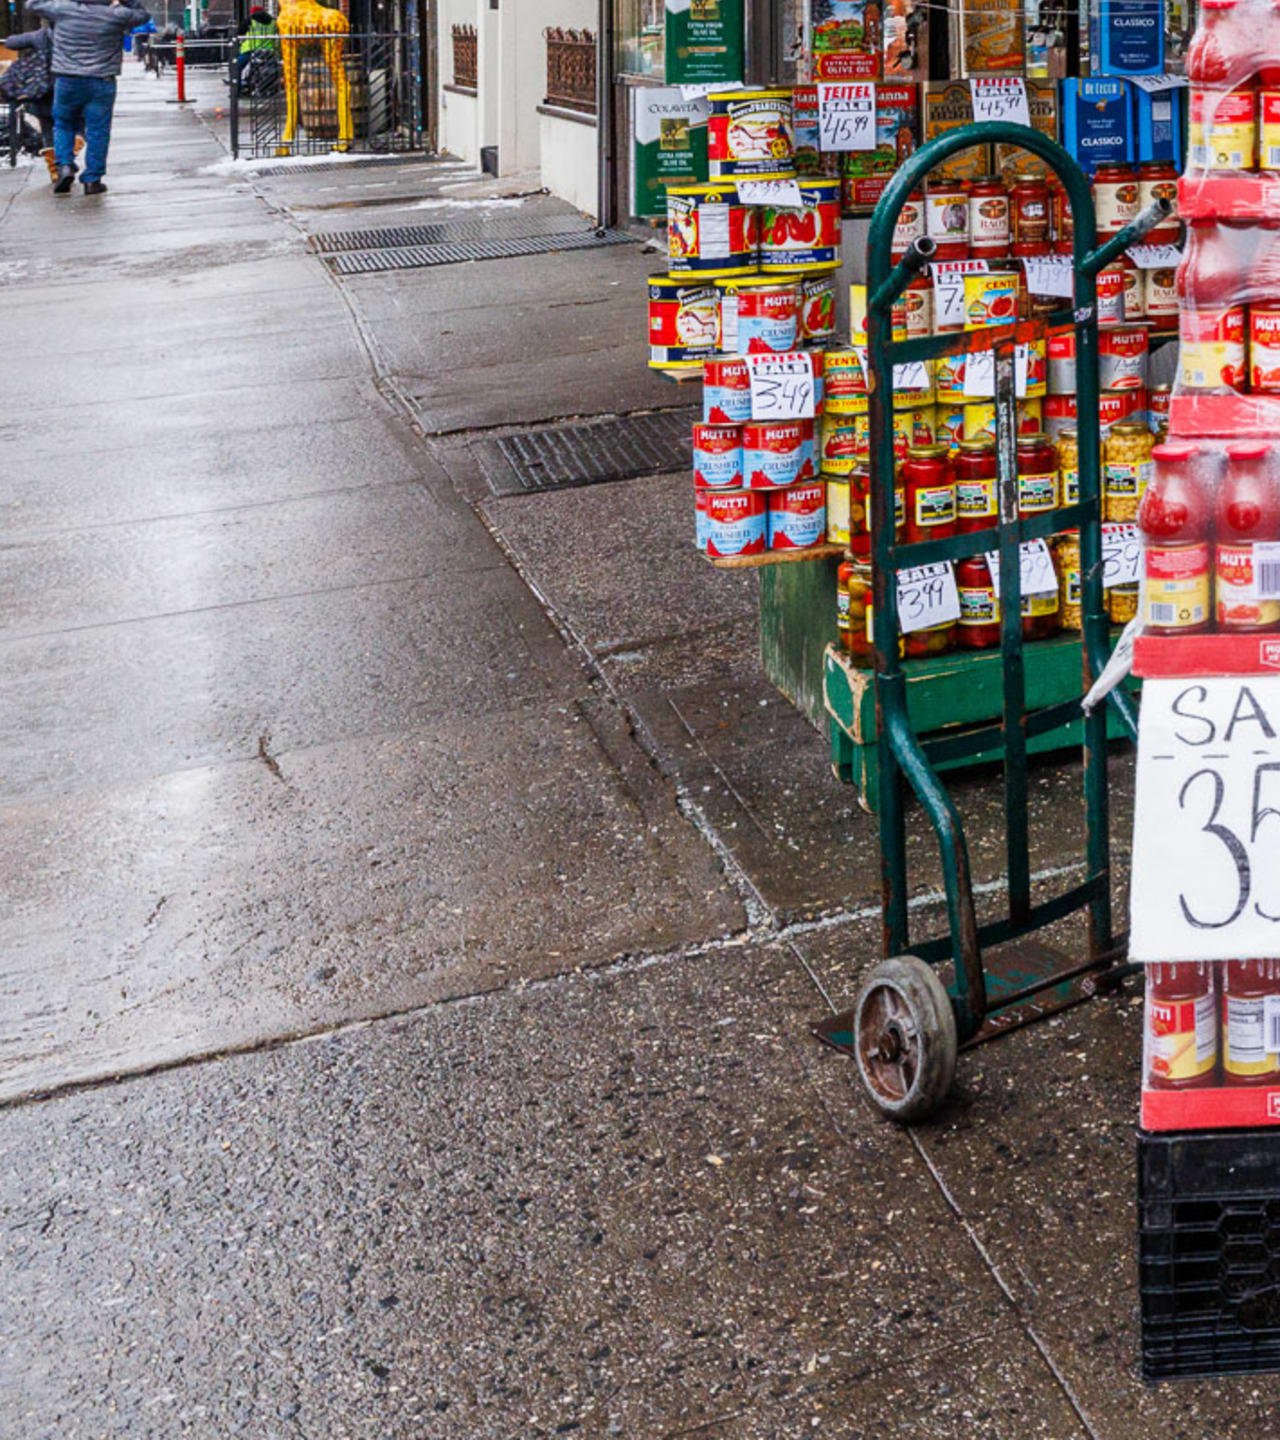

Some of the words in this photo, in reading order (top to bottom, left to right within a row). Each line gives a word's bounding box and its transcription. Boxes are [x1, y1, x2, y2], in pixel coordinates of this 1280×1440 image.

[1114, 18, 1155, 27] CLASSICO
[823, 85, 871, 101] TEITEL
[1081, 136, 1123, 147] CLASSICO
[937, 262, 984, 274] TEITEL
[1112, 333, 1144, 345] MUTTI
[753, 378, 812, 414] 3.49
[700, 429, 737, 441] MUTTI
[765, 427, 799, 440] MUTTI
[786, 488, 822, 501] MUTTI
[712, 497, 749, 510] MUTTI
